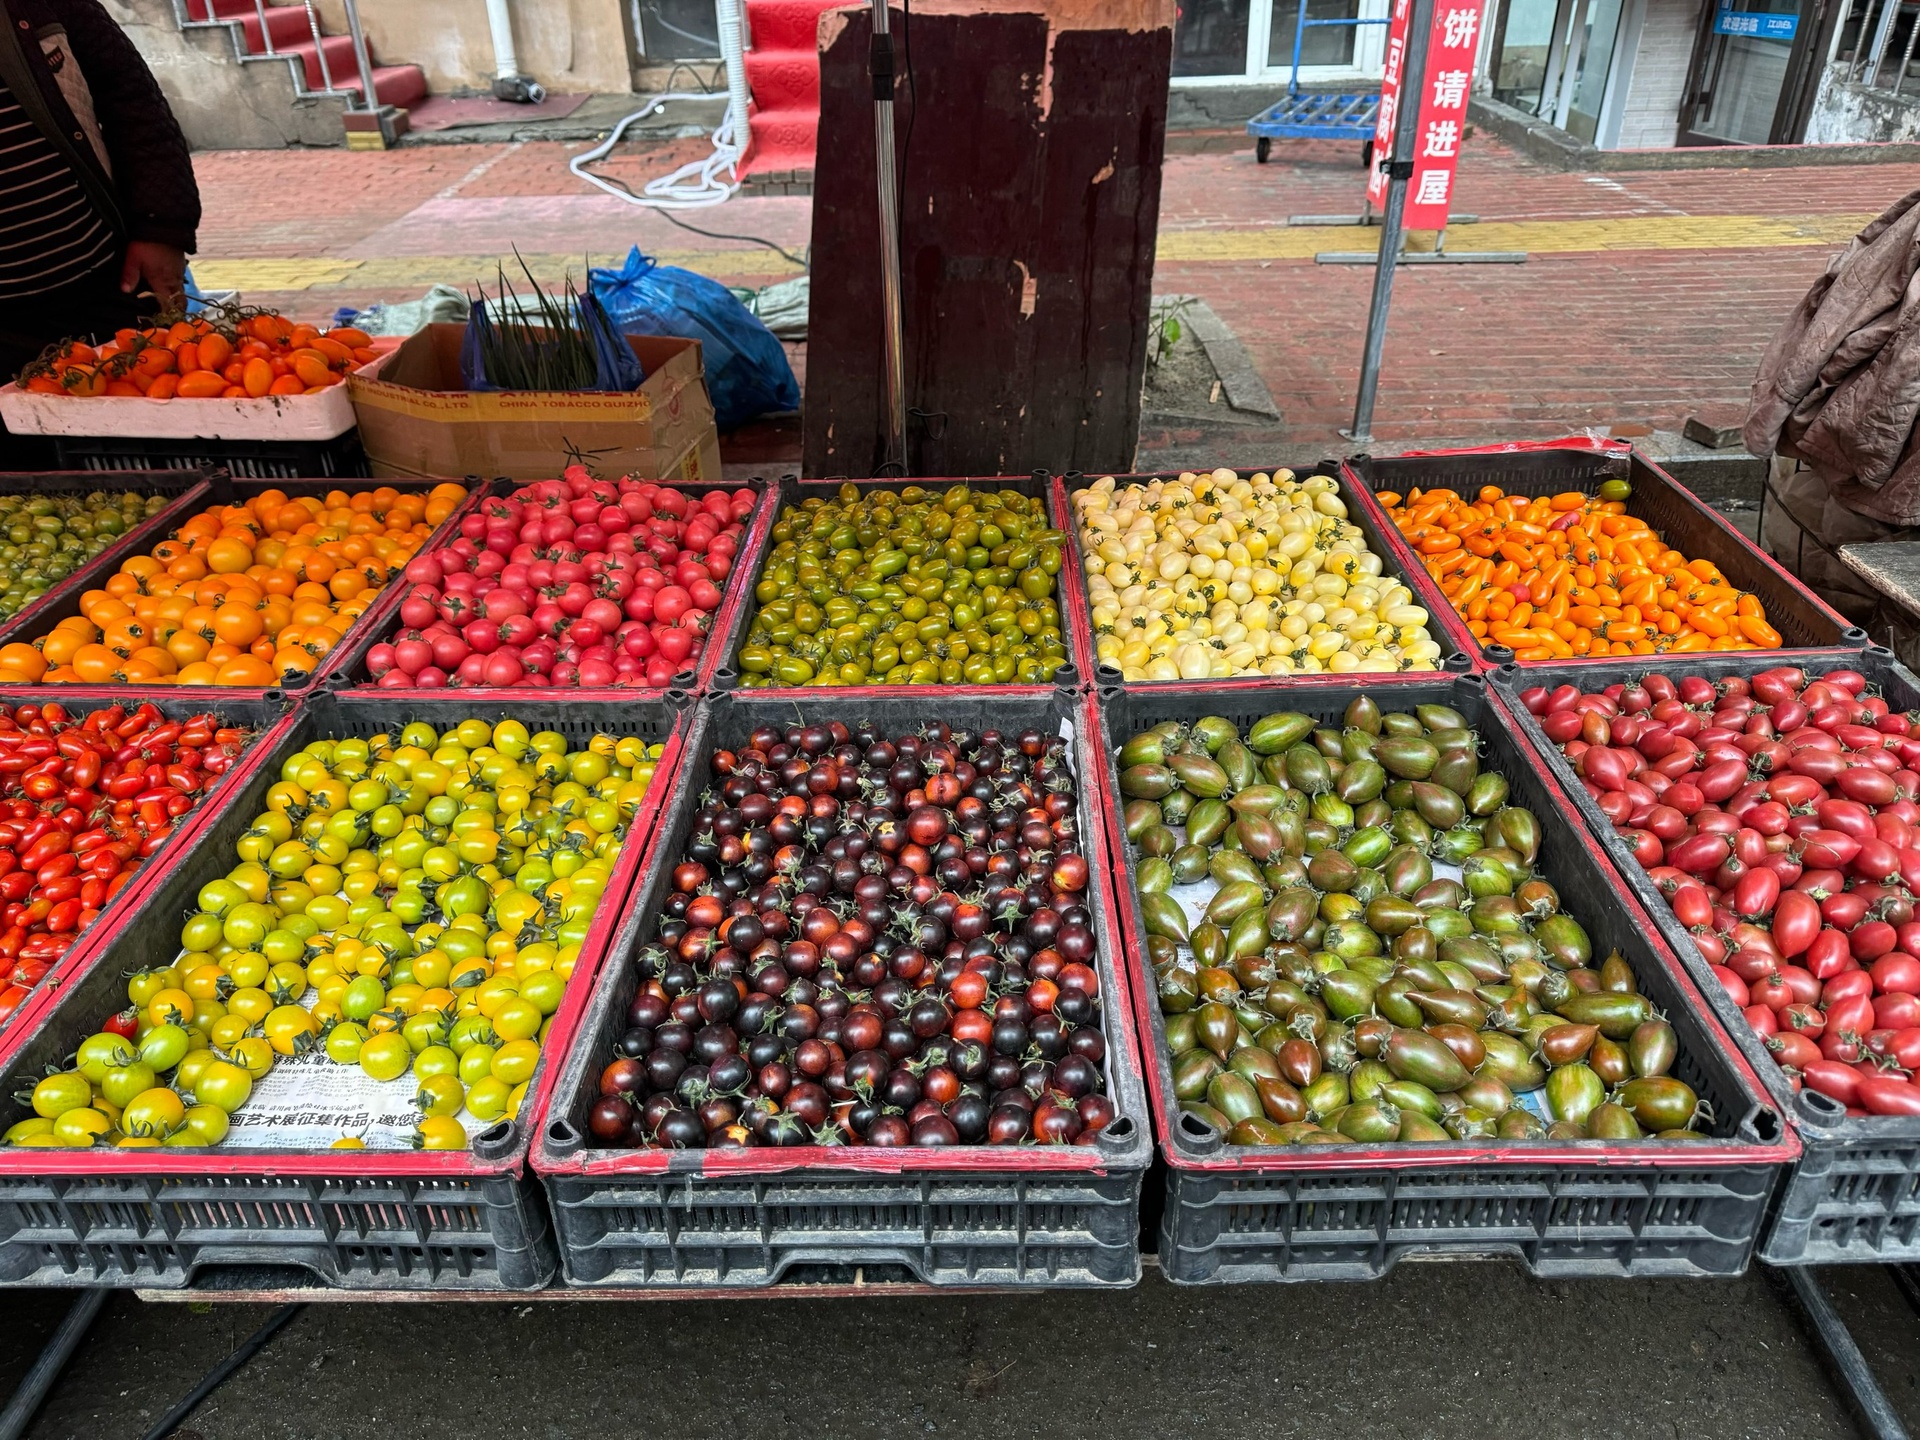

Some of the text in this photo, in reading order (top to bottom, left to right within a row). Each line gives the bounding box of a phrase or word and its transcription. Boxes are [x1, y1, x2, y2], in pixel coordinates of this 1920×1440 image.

[1721, 16, 1760, 32] 欢迎光临
[1414, 8, 1478, 206] 饼请进屋
[367, 387, 421, 405] INDUSTRIAL
